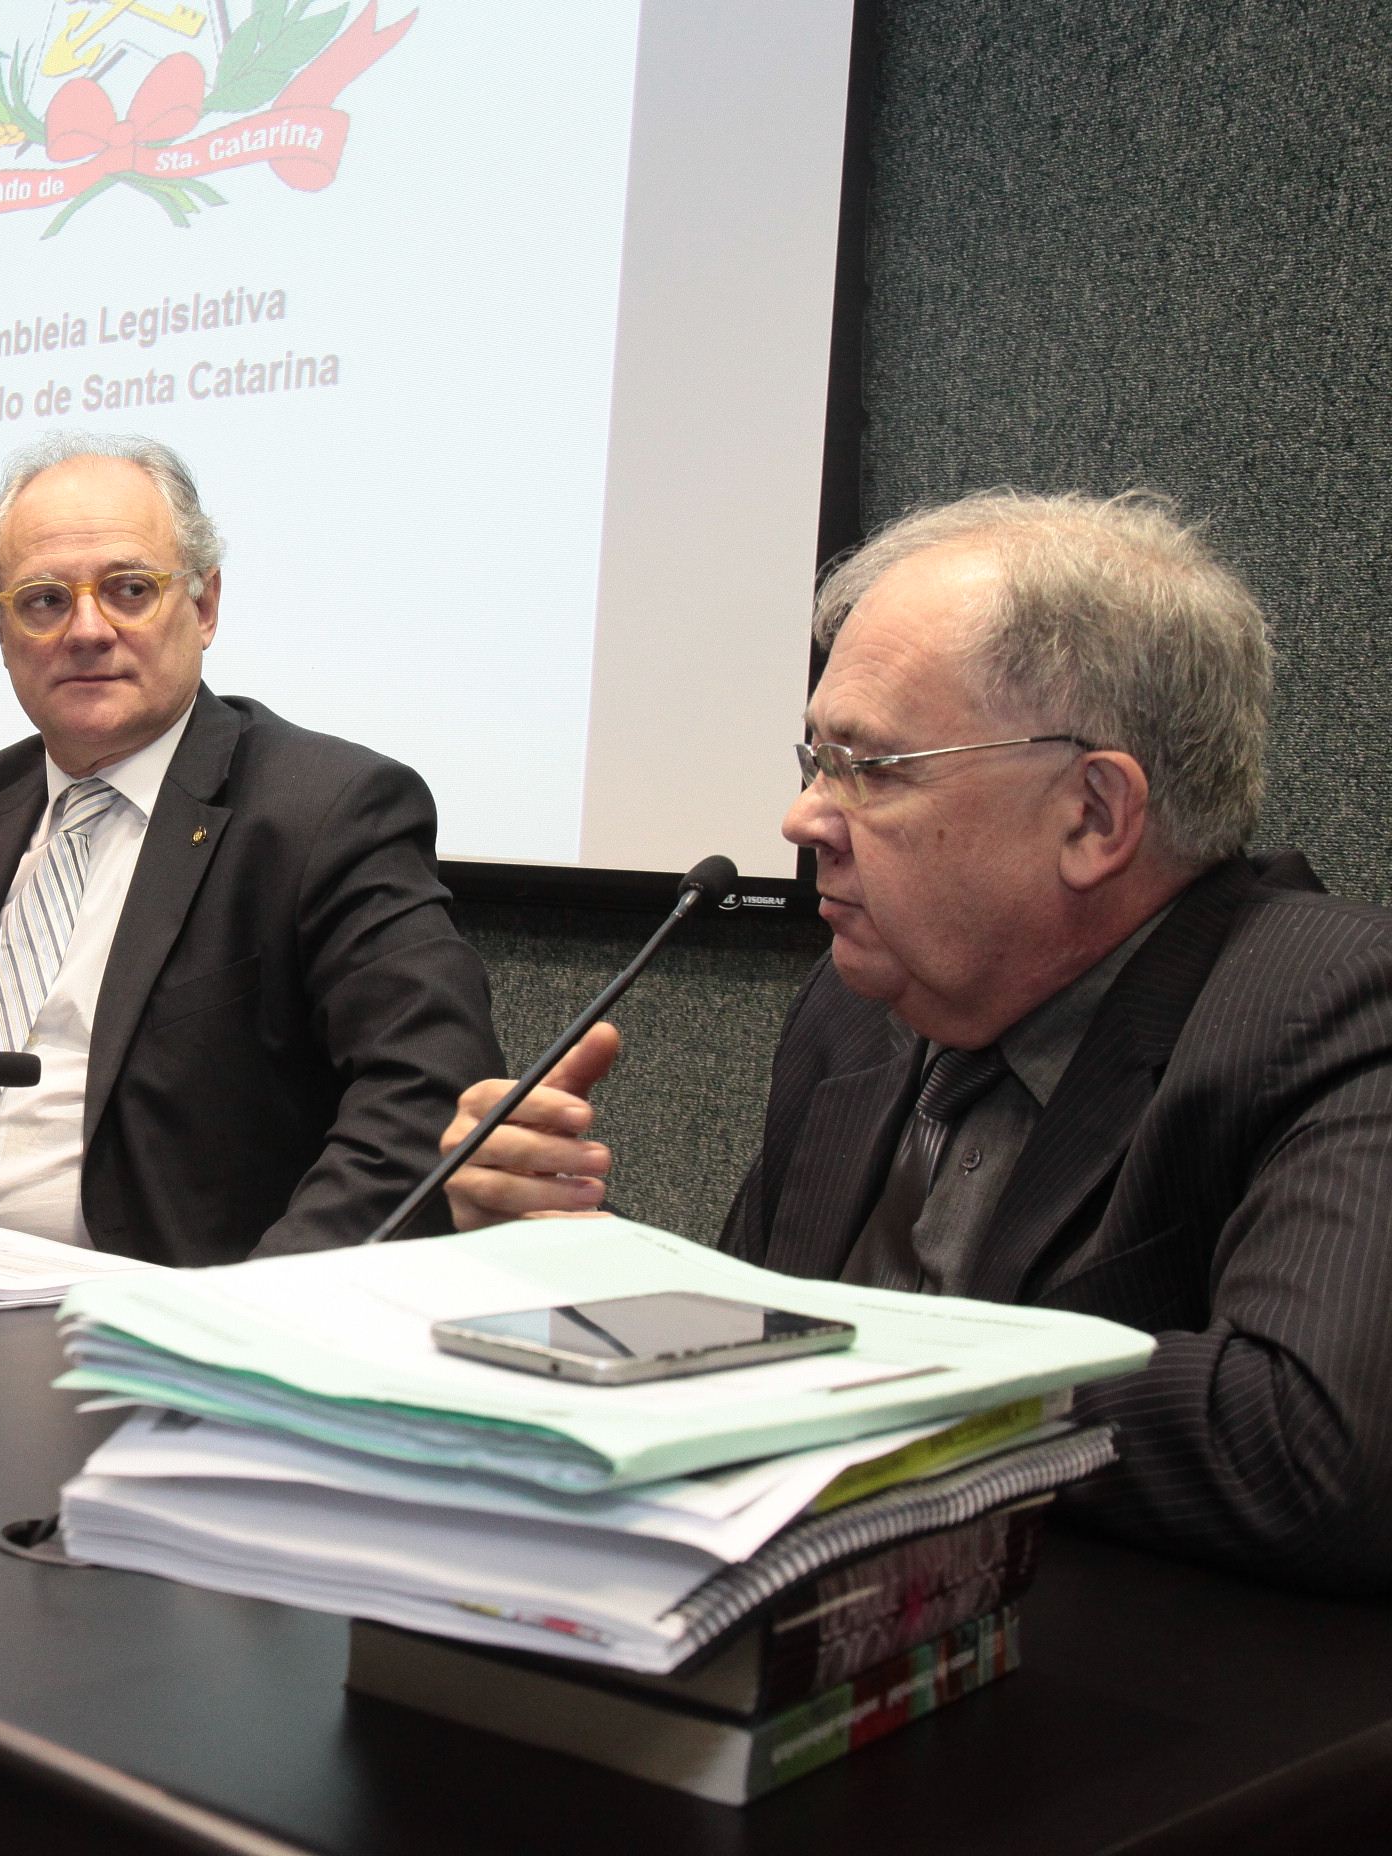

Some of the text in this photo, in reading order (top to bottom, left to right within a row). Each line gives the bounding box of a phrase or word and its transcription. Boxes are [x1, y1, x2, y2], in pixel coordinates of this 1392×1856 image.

[155, 119, 324, 173] Sta. Catarina
[38, 175, 65, 197] de
[99, 287, 287, 348] Legislativa
[34, 380, 72, 417] de
[83, 367, 176, 412] Santa
[187, 352, 340, 400] Catarina
[741, 895, 786, 905] VISOGRAF
